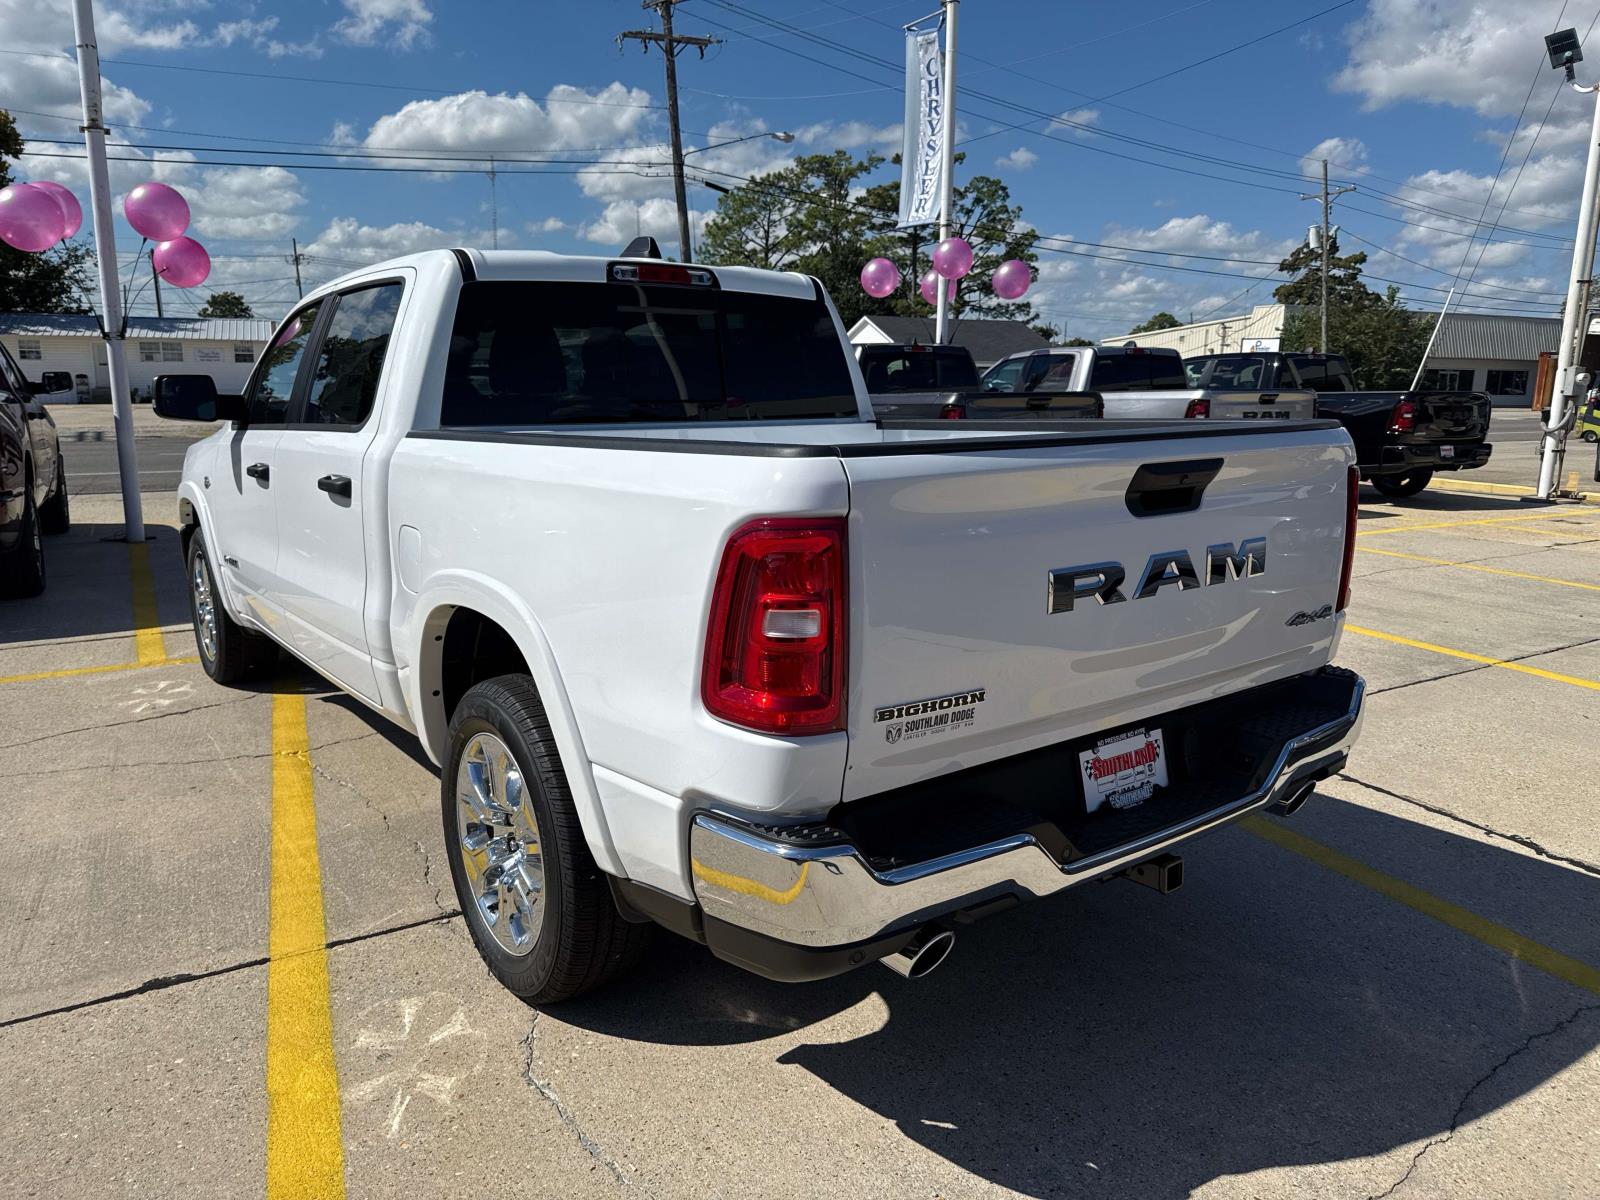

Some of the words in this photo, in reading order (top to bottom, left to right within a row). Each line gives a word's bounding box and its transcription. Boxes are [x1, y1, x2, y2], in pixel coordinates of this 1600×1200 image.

[915, 57, 941, 214] CHRYSLER
[1047, 536, 1267, 615] RAM
[876, 690, 985, 722] BIGHORN
[904, 712, 949, 733] SOUTHLAND
[950, 707, 976, 723] DODGE
[1097, 739, 1105, 747] NO
[1104, 732, 1127, 744] PRESSURE
[1127, 730, 1136, 738] NO
[1091, 741, 1157, 779] SOUTHLAND
